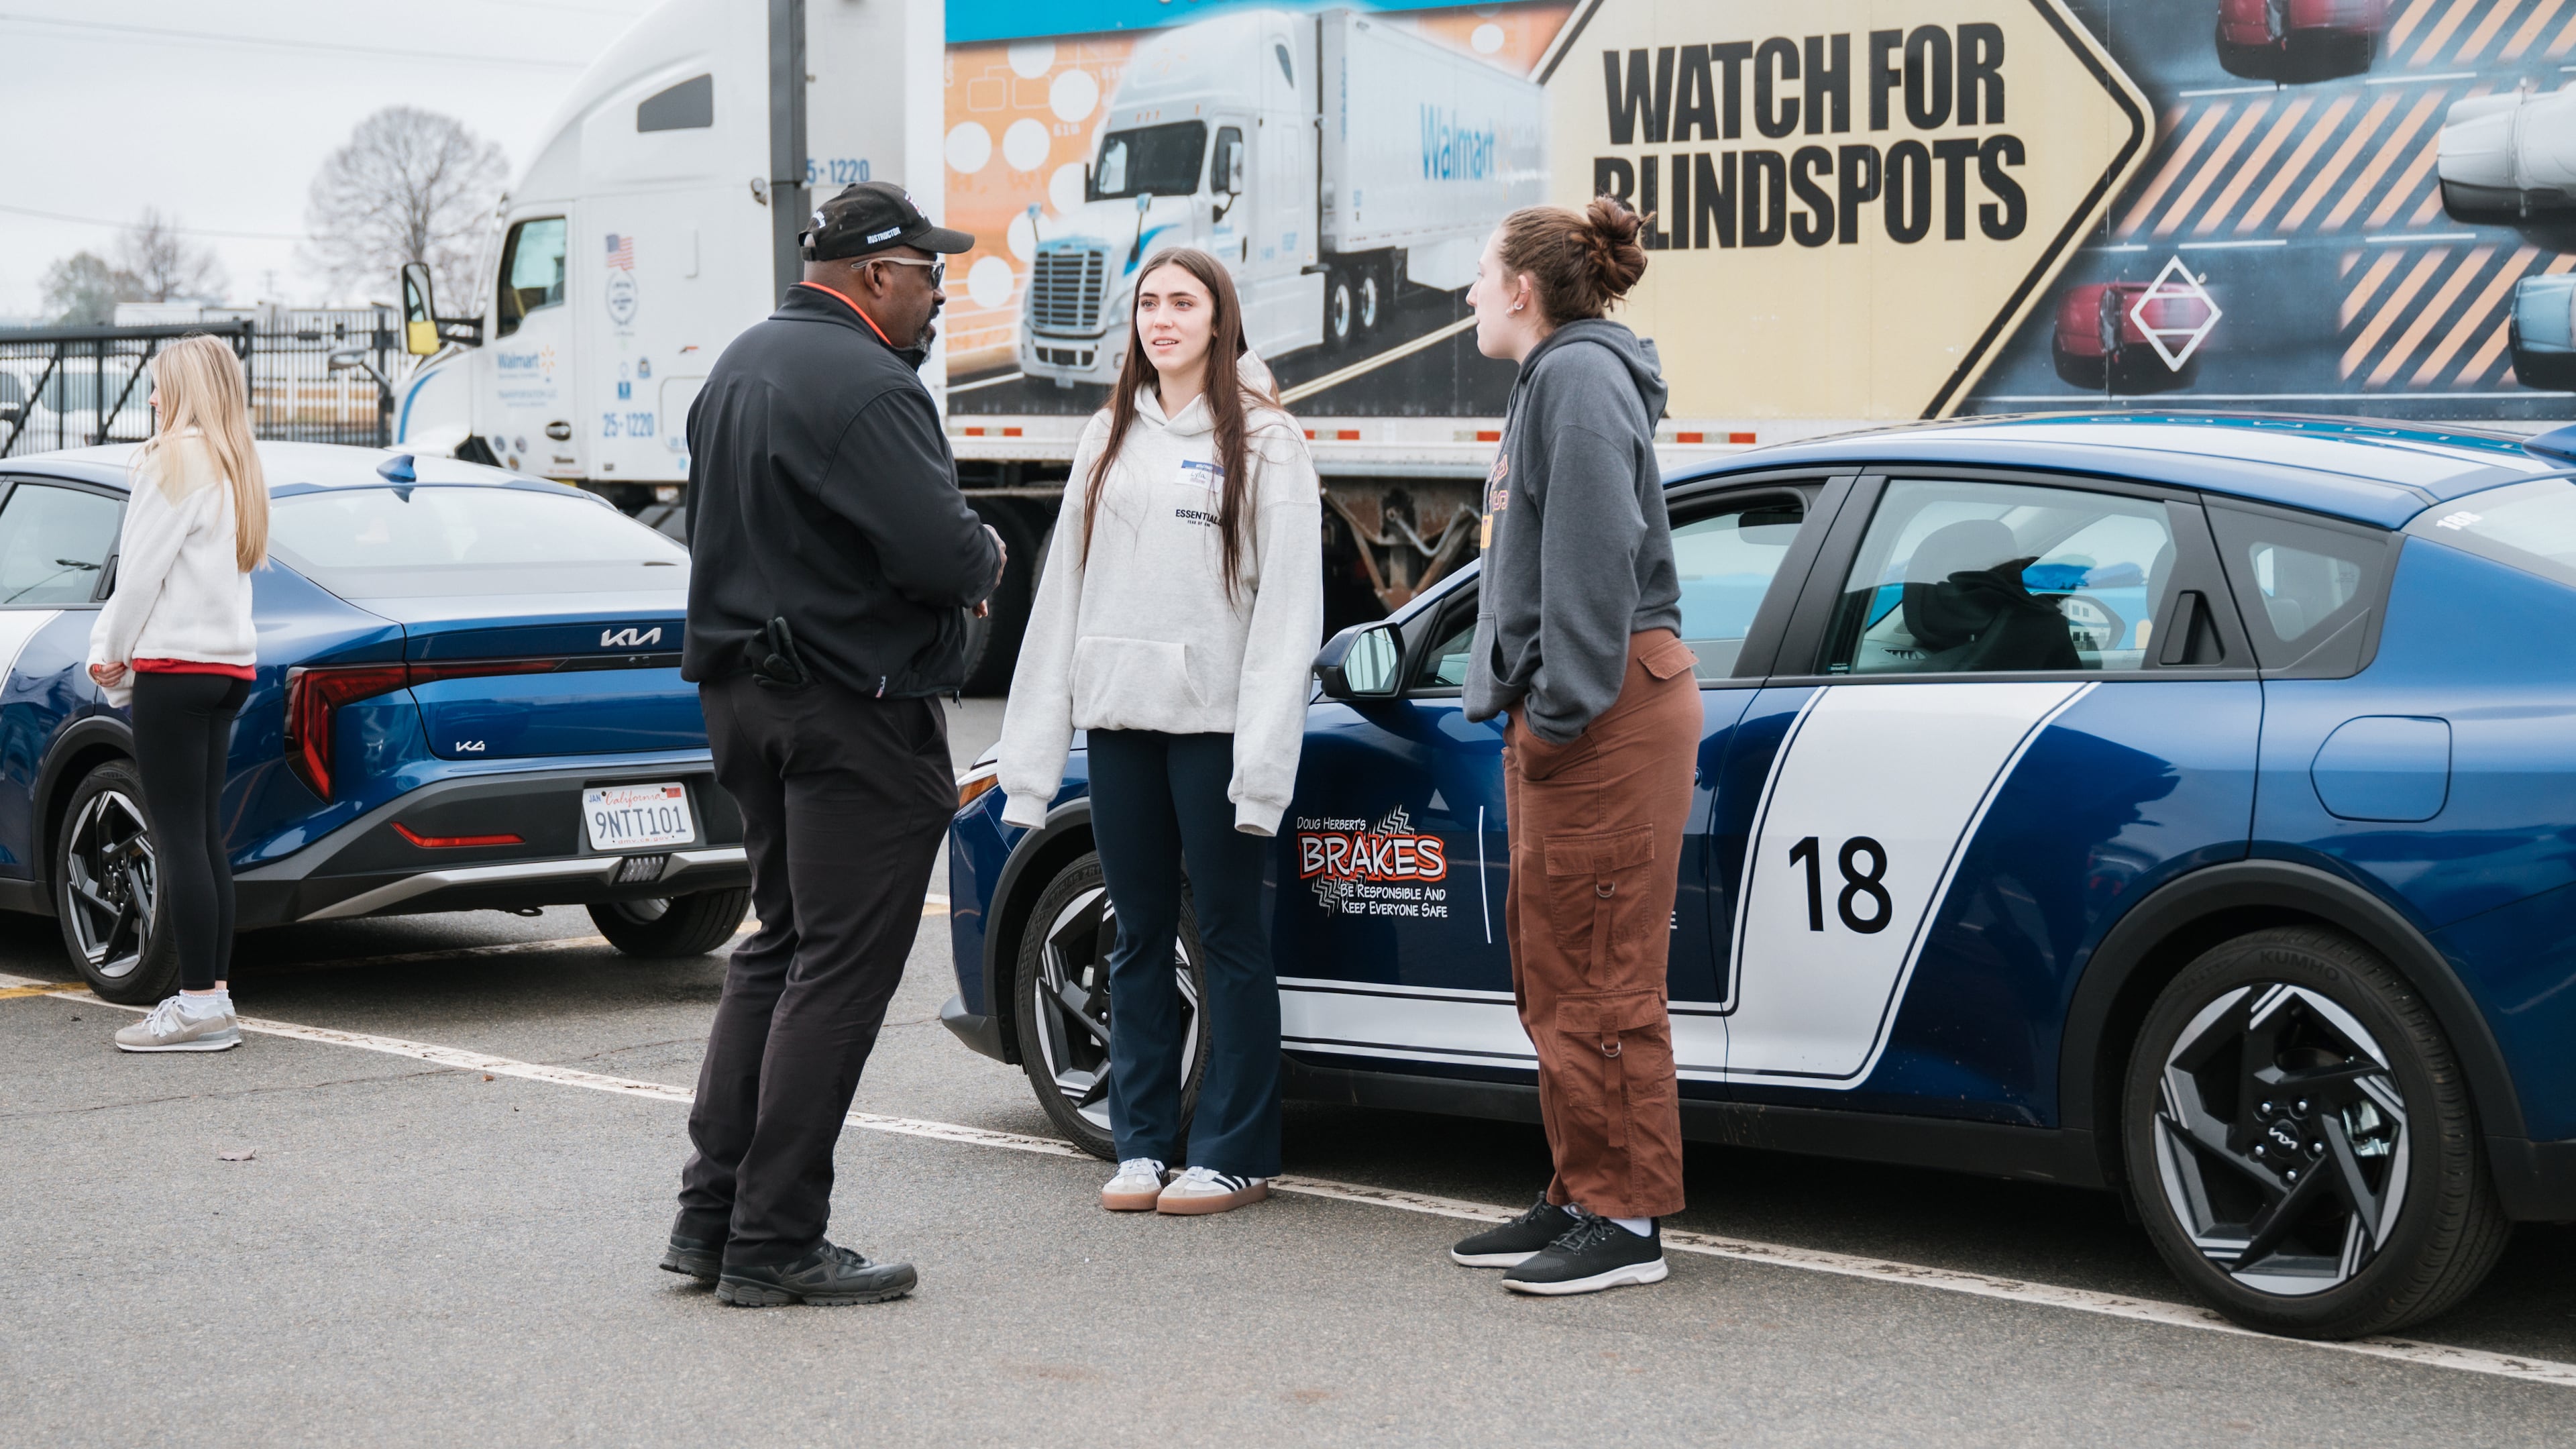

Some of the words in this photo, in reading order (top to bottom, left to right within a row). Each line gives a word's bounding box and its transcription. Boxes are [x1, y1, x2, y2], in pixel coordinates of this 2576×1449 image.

[1603, 32, 1851, 146] WATCH
[1869, 22, 2005, 132] FOR
[1419, 101, 1495, 180] Walmart
[1593, 134, 2028, 251] BLINDSPOTS
[867, 226, 902, 245] INSTRUCTOR
[1175, 508, 1224, 527] ESSENTIALS
[600, 627, 662, 647] KIA
[456, 741, 485, 753] K4
[589, 794, 601, 803] JAN
[605, 790, 667, 808] California
[595, 806, 686, 839] 9NTT101
[1297, 816, 1321, 830] DOUG
[1324, 816, 1366, 831] HERBERT'S
[1341, 883, 1354, 898] BE
[1357, 883, 1421, 901] RESPONSIBLE
[1424, 885, 1446, 902] AND
[1789, 835, 1892, 934] 18
[1342, 900, 1366, 914] KEEP
[1369, 902, 1419, 918] EVERYONE
[1421, 903, 1448, 918] SAFE
[2261, 951, 2340, 982] KUMHO
